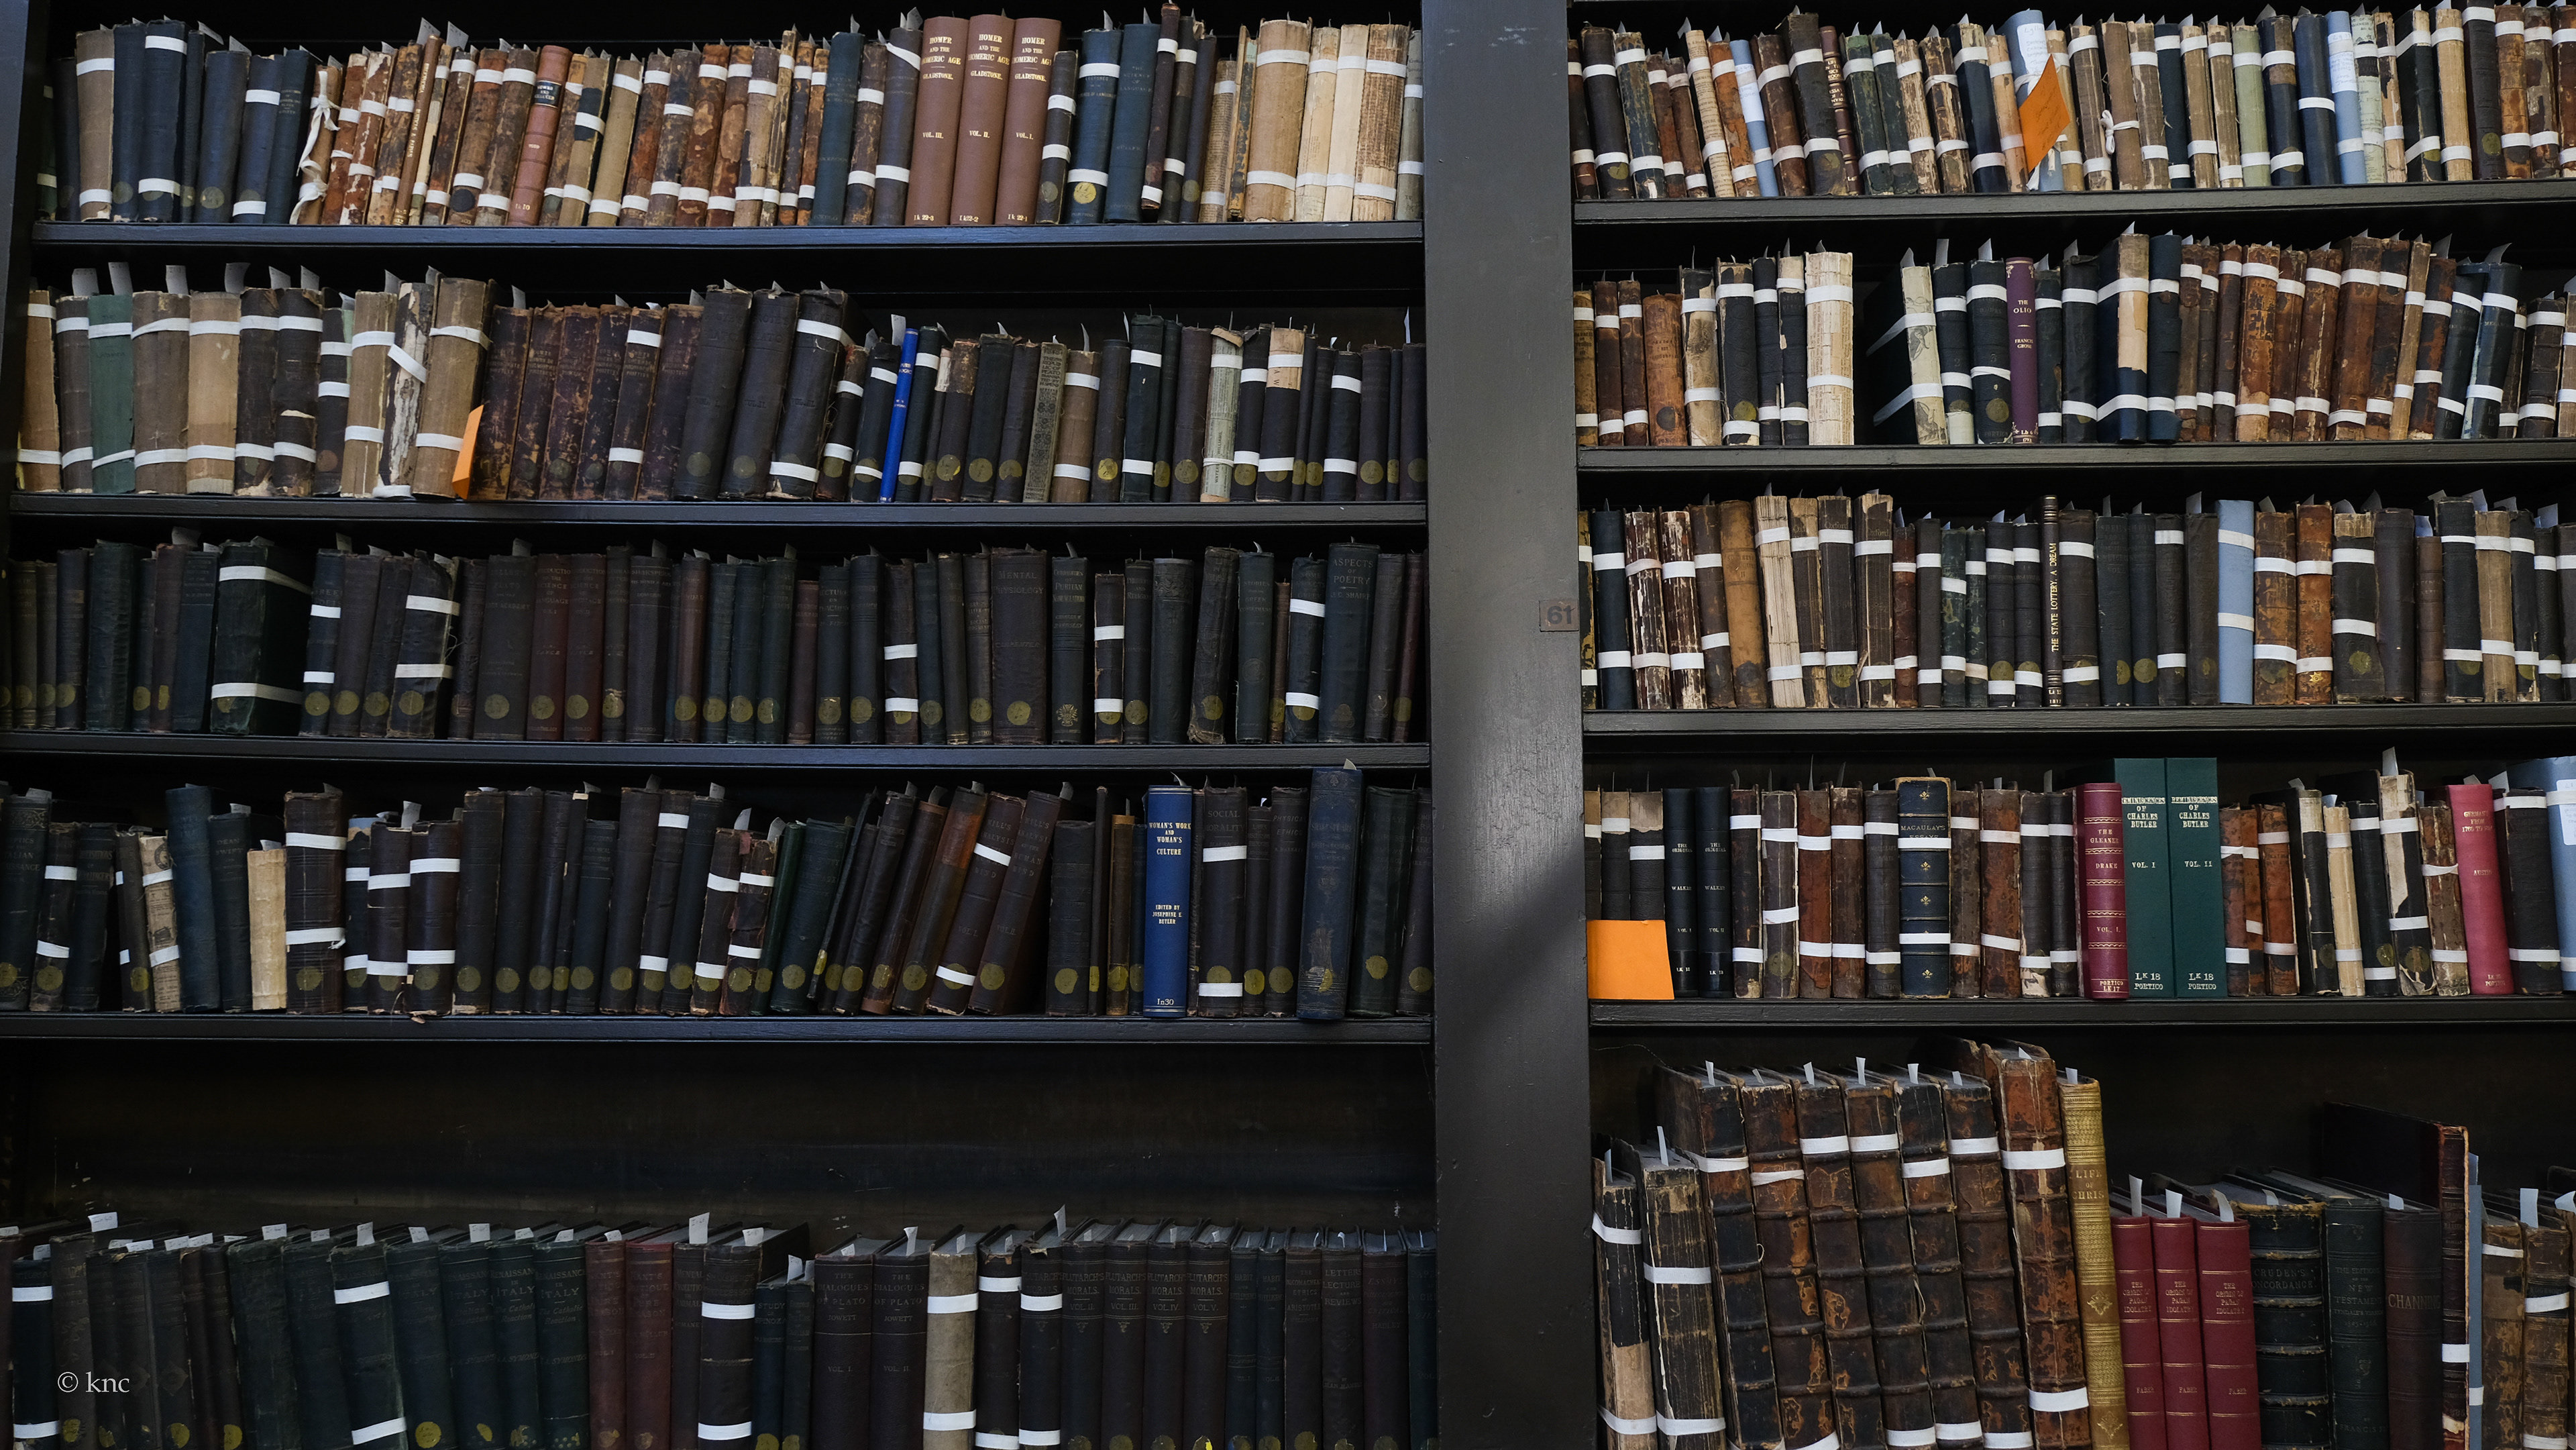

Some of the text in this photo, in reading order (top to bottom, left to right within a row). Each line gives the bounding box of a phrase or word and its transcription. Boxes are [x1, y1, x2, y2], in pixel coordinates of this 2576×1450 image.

[930, 36, 952, 44] HOMER
[979, 34, 1002, 43] HOMER
[1022, 37, 1045, 45] HOMER
[947, 57, 961, 65] AGE
[998, 56, 1010, 66] AGE
[1824, 521, 1849, 530] Oxford
[1332, 559, 1373, 568] ASPECTS
[998, 571, 1036, 579] MENTAL
[1334, 576, 1371, 585] POETRY
[993, 586, 1044, 594] PHYSIOLOGY
[1055, 583, 1083, 591] PURITAN
[2050, 580, 2059, 611] LOTTERY,
[1547, 605, 1572, 625] 61
[2051, 613, 2059, 635] STATE
[1208, 810, 1240, 818] SOCIAL
[2127, 813, 2158, 821] CHARLES
[2179, 812, 2210, 820] CHARLES
[2076, 1170, 2102, 1178] LIFE
[2072, 1190, 2104, 1200] CHRIS
[2254, 1268, 2306, 1278] CRUDEN'S
[1062, 1273, 1104, 1282] PLUTARCH'S
[1187, 1274, 1228, 1282] PLUTARCH'S
[497, 1286, 536, 1296] ITALY
[817, 1283, 869, 1291] DIALOGUES
[874, 1283, 925, 1291] DIALOGUES
[1067, 1286, 1099, 1294] MORALS.
[1109, 1286, 1141, 1294] MORALS.
[1151, 1287, 1184, 1295] MORALS.
[1190, 1287, 1223, 1295] MORALS.
[2349, 1284, 2373, 1292] NEW
[541, 1288, 580, 1298] ITALY
[832, 1297, 866, 1306] PLATO
[890, 1297, 922, 1306] PLATO
[1324, 1298, 1362, 1306] REVIEWS
[2388, 1294, 2441, 1309] CHANNING
[553, 1305, 583, 1314] Catholic
[2216, 1306, 2245, 1314] IDOLATRY
[545, 1316, 576, 1325] Reaction
[551, 1354, 587, 1365] SYMONDS
